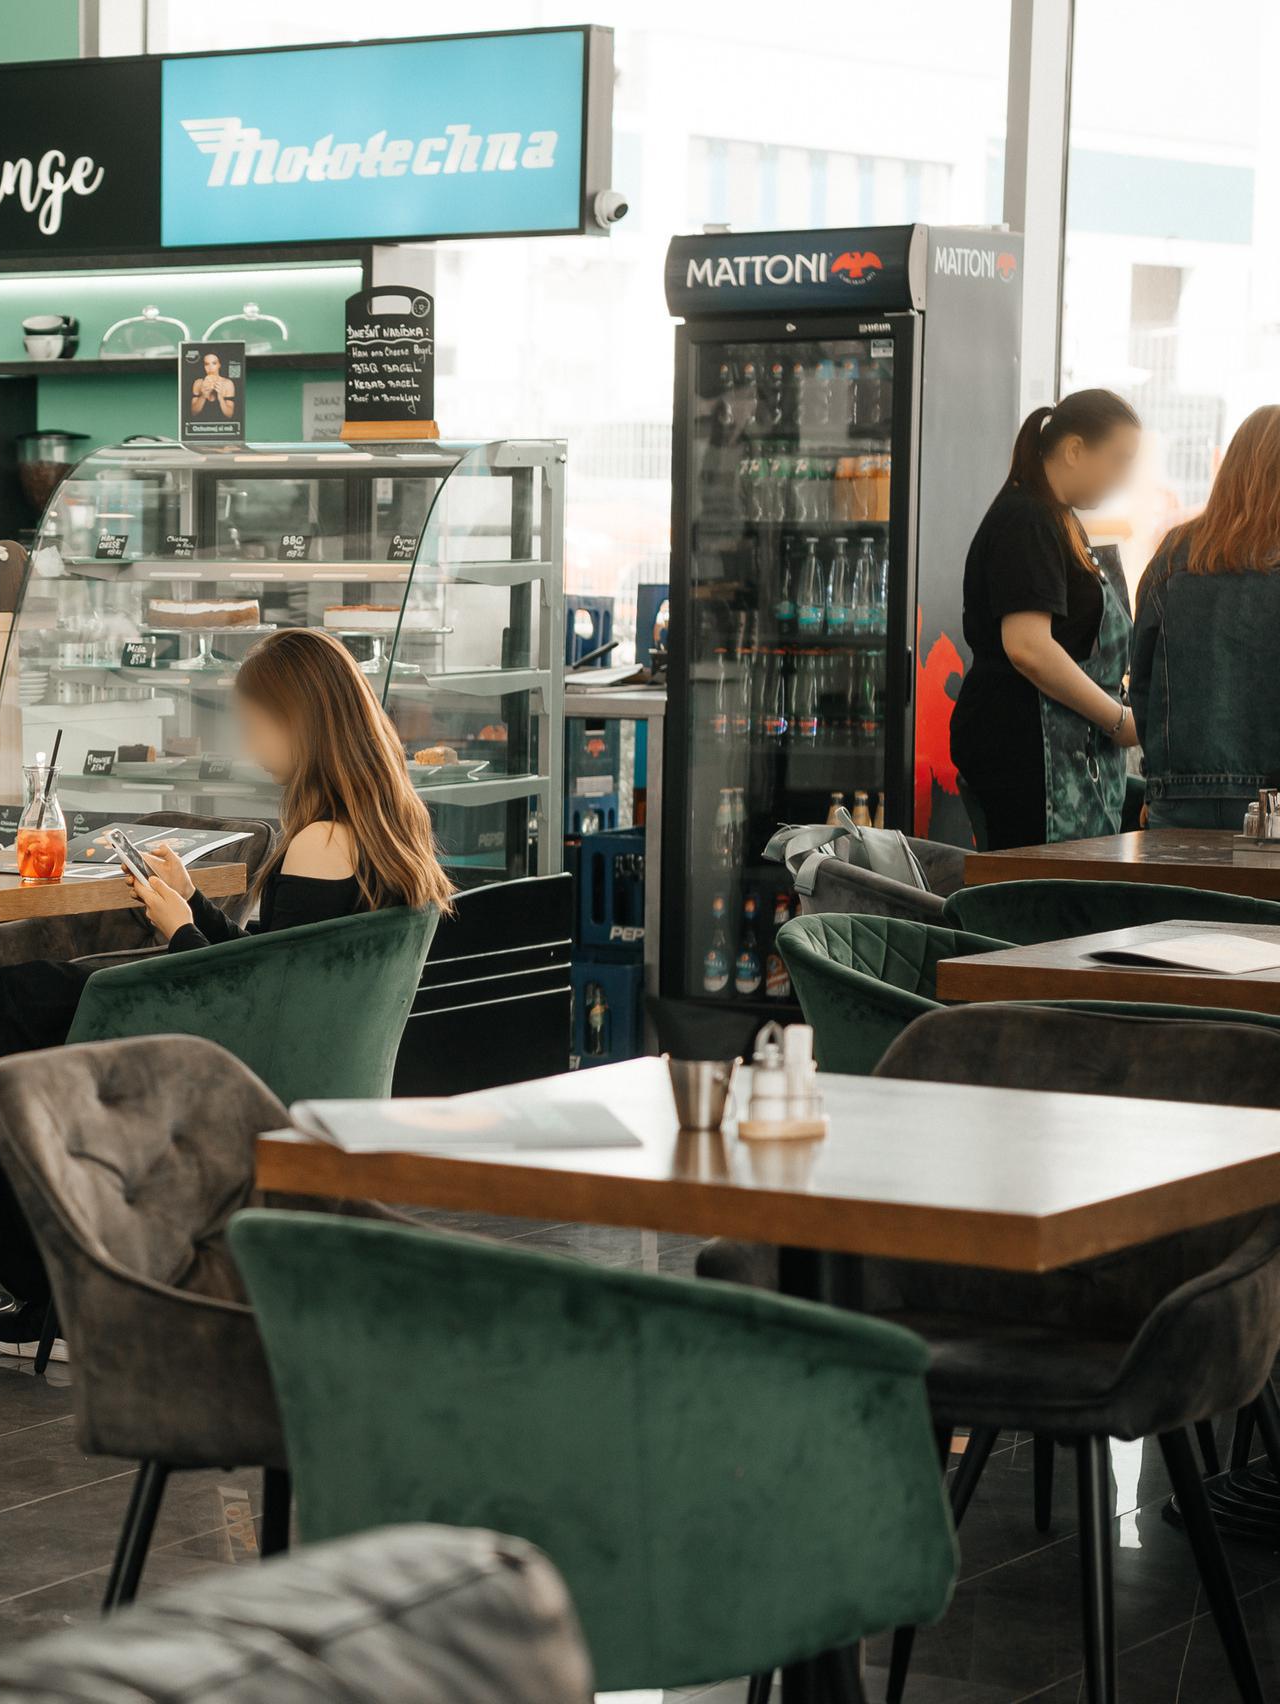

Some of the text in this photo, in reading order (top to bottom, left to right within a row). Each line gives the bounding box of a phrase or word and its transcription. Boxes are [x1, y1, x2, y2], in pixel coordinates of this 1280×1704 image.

[179, 116, 558, 188] Mototechna
[686, 251, 828, 288] MATTONI
[935, 246, 995, 279] MATTONI
[351, 361, 422, 374] BBQ BAGEL
[282, 535, 304, 545] BBQ
[393, 535, 417, 549] Gyros
[610, 925, 645, 942] PEP
